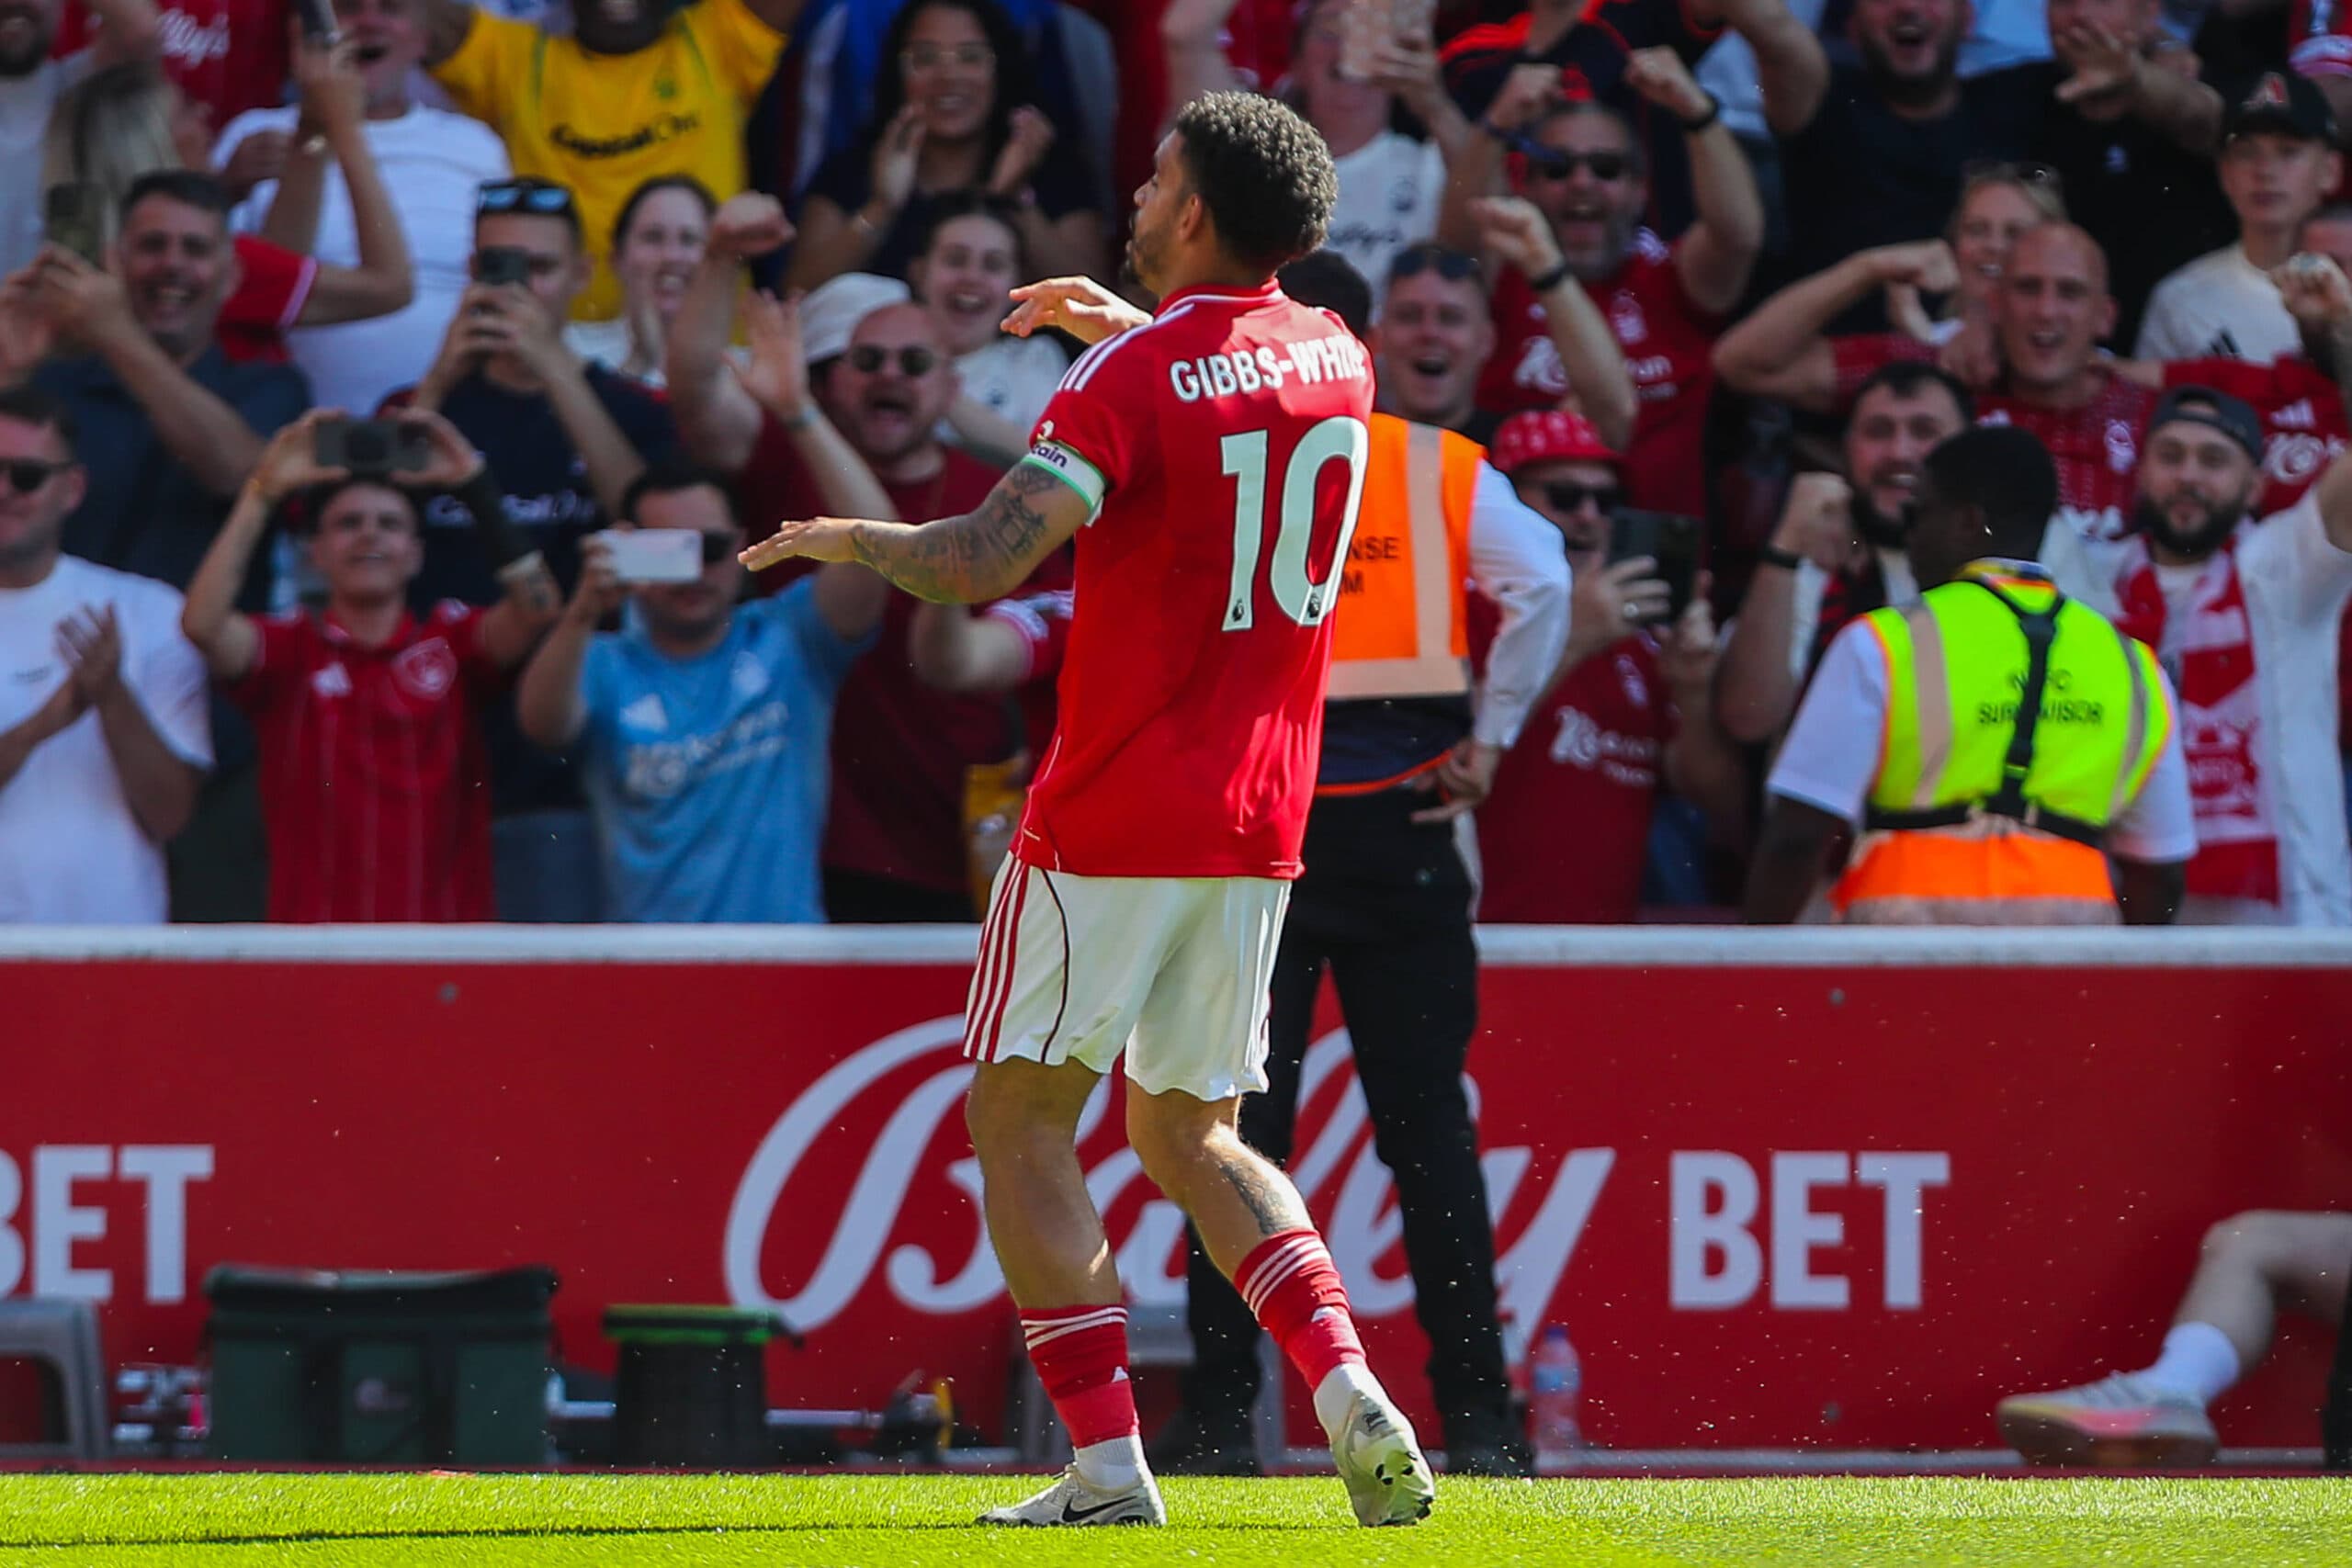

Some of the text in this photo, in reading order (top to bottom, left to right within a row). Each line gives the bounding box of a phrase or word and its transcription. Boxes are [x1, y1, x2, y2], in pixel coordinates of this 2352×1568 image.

[1170, 334, 1367, 404] GIBBS-WHITE
[1032, 445, 1069, 468] ain
[1220, 415, 1369, 631] 10
[1670, 1150, 1951, 1311] BET
